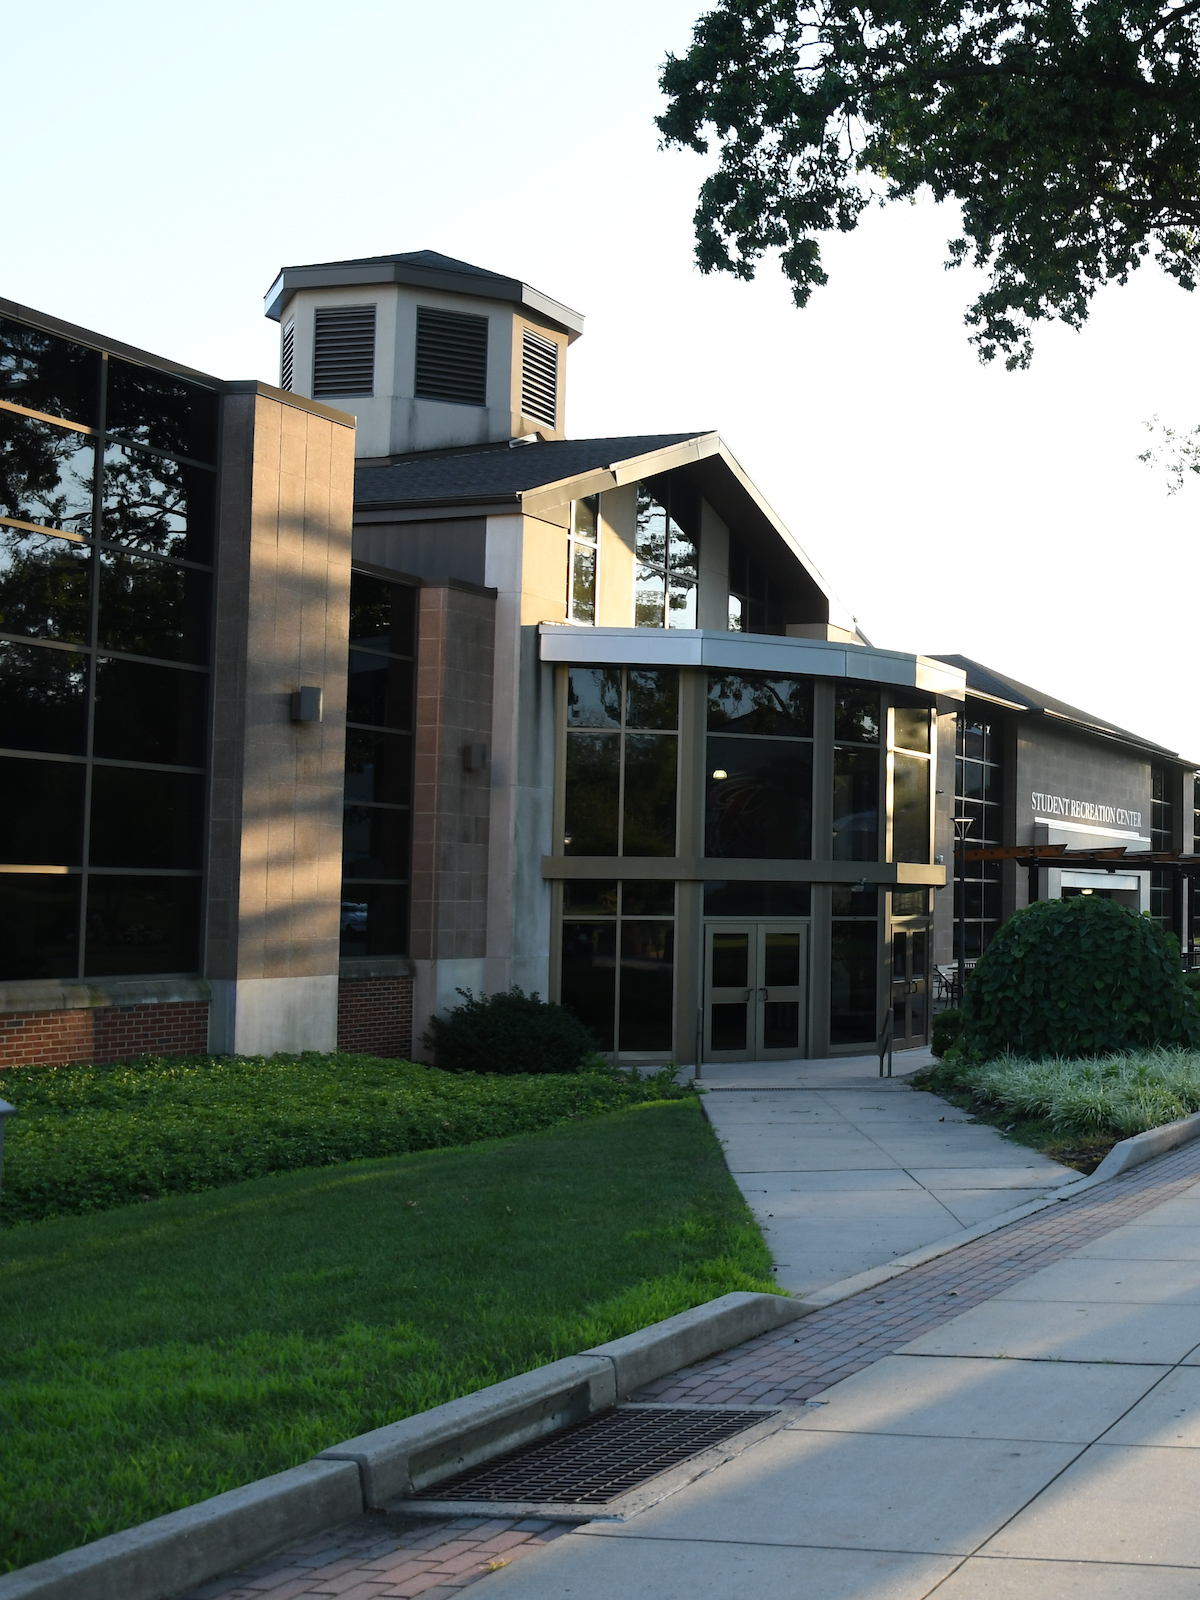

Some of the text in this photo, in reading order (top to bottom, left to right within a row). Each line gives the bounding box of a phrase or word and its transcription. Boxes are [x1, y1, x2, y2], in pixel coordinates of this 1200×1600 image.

[1031, 791, 1142, 828] STUDENT RECREATION CENTER
